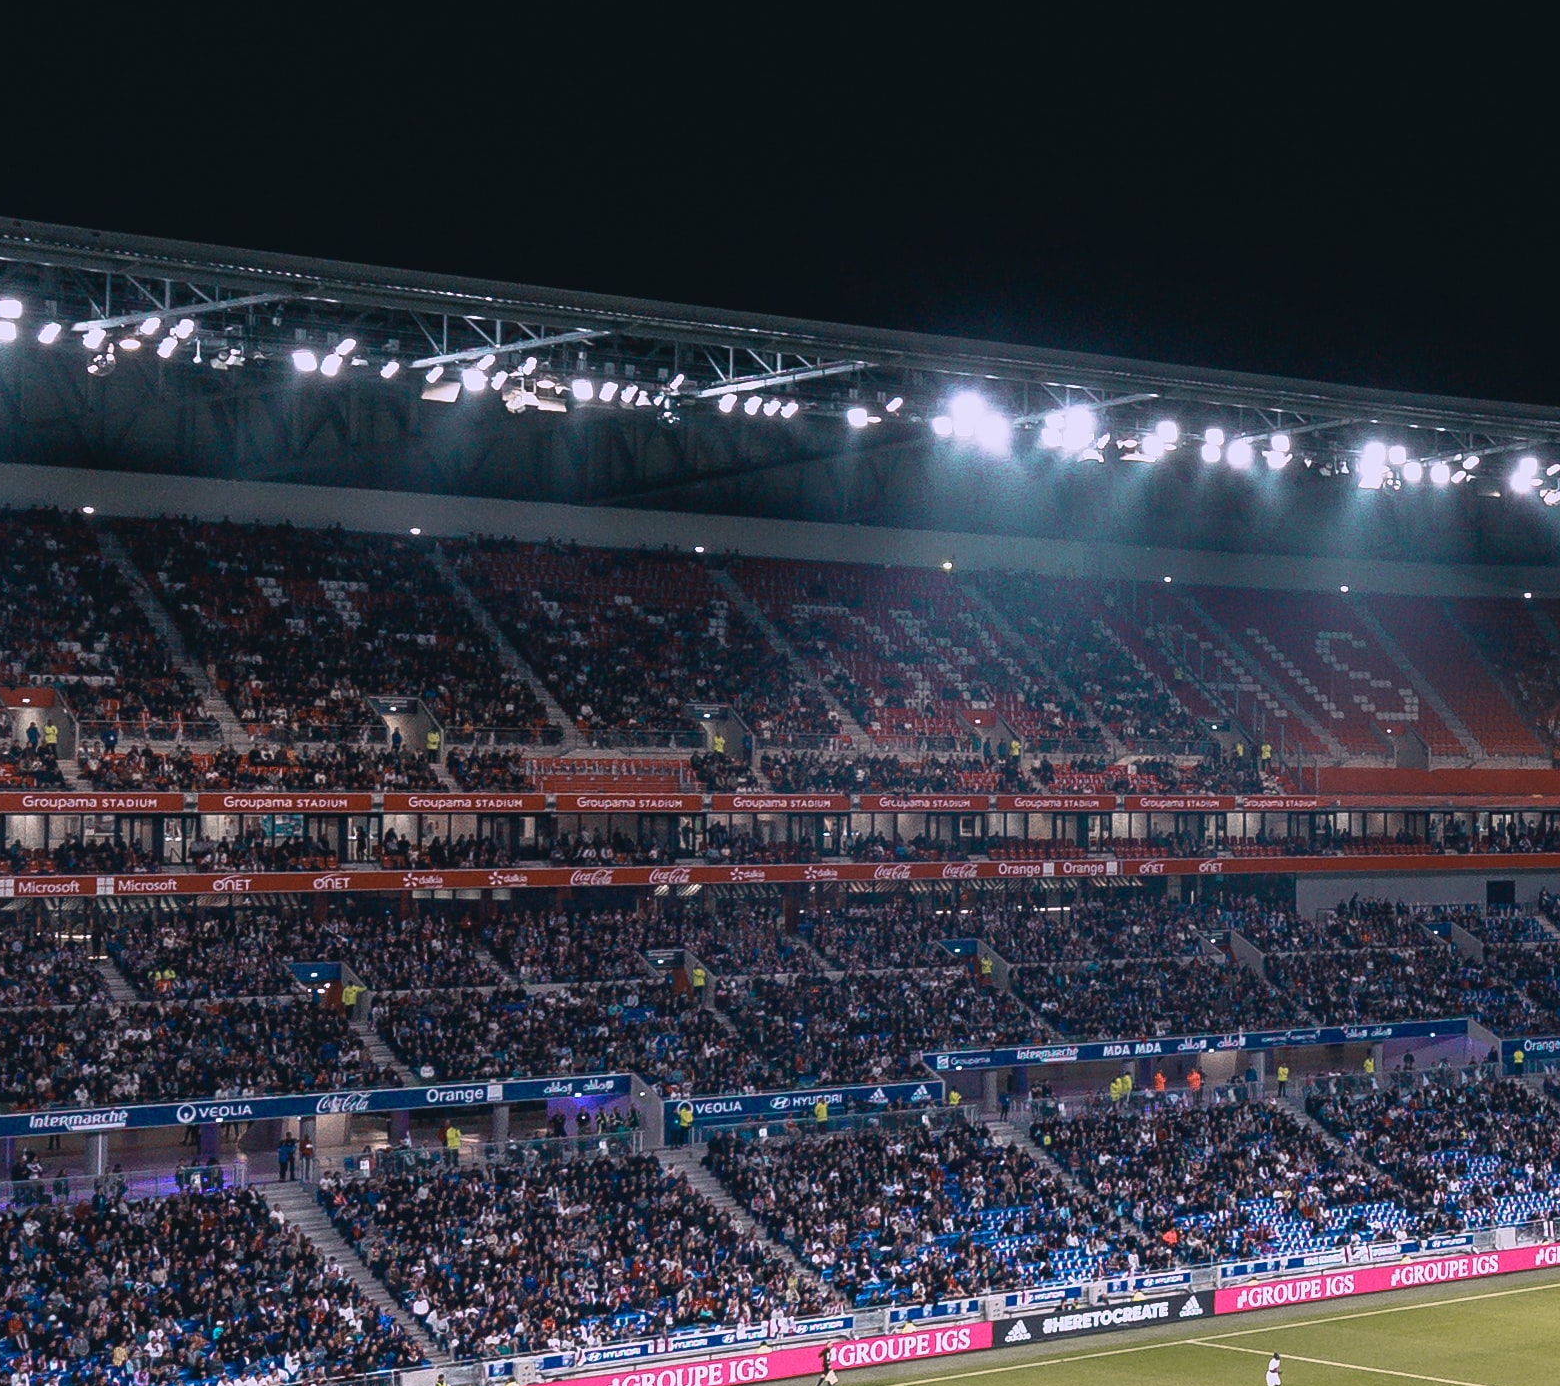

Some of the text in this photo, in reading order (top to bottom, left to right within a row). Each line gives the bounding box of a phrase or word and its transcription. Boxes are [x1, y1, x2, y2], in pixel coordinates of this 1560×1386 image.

[22, 795, 157, 809] Groupama STADIUM
[223, 796, 347, 809] Groupama STADIUM
[408, 796, 522, 809] Groupama STADIUM
[576, 797, 682, 810] Groupama STADIUM
[732, 797, 831, 809] Groupama STADIUM
[931, 799, 970, 808] STADIUM
[1014, 797, 1060, 809] Groupama
[998, 863, 1040, 876] Orange
[1063, 863, 1104, 875] Orange
[18, 880, 80, 894] Microsoft
[118, 879, 177, 893] Microsoft
[1103, 1042, 1161, 1056] MDA MDA
[1524, 1039, 1560, 1052] Orange
[427, 1087, 483, 1103] Orange
[199, 1104, 252, 1118] VEOLIA
[695, 1100, 743, 1113] VEOLIA
[1401, 1254, 1499, 1283] GROUPE IGS
[1247, 1274, 1355, 1306] GROUPE IGS
[1043, 1302, 1169, 1334] #HERETOCREATE
[834, 1328, 972, 1367] GROUPE IGS
[730, 1357, 768, 1380] IGS
